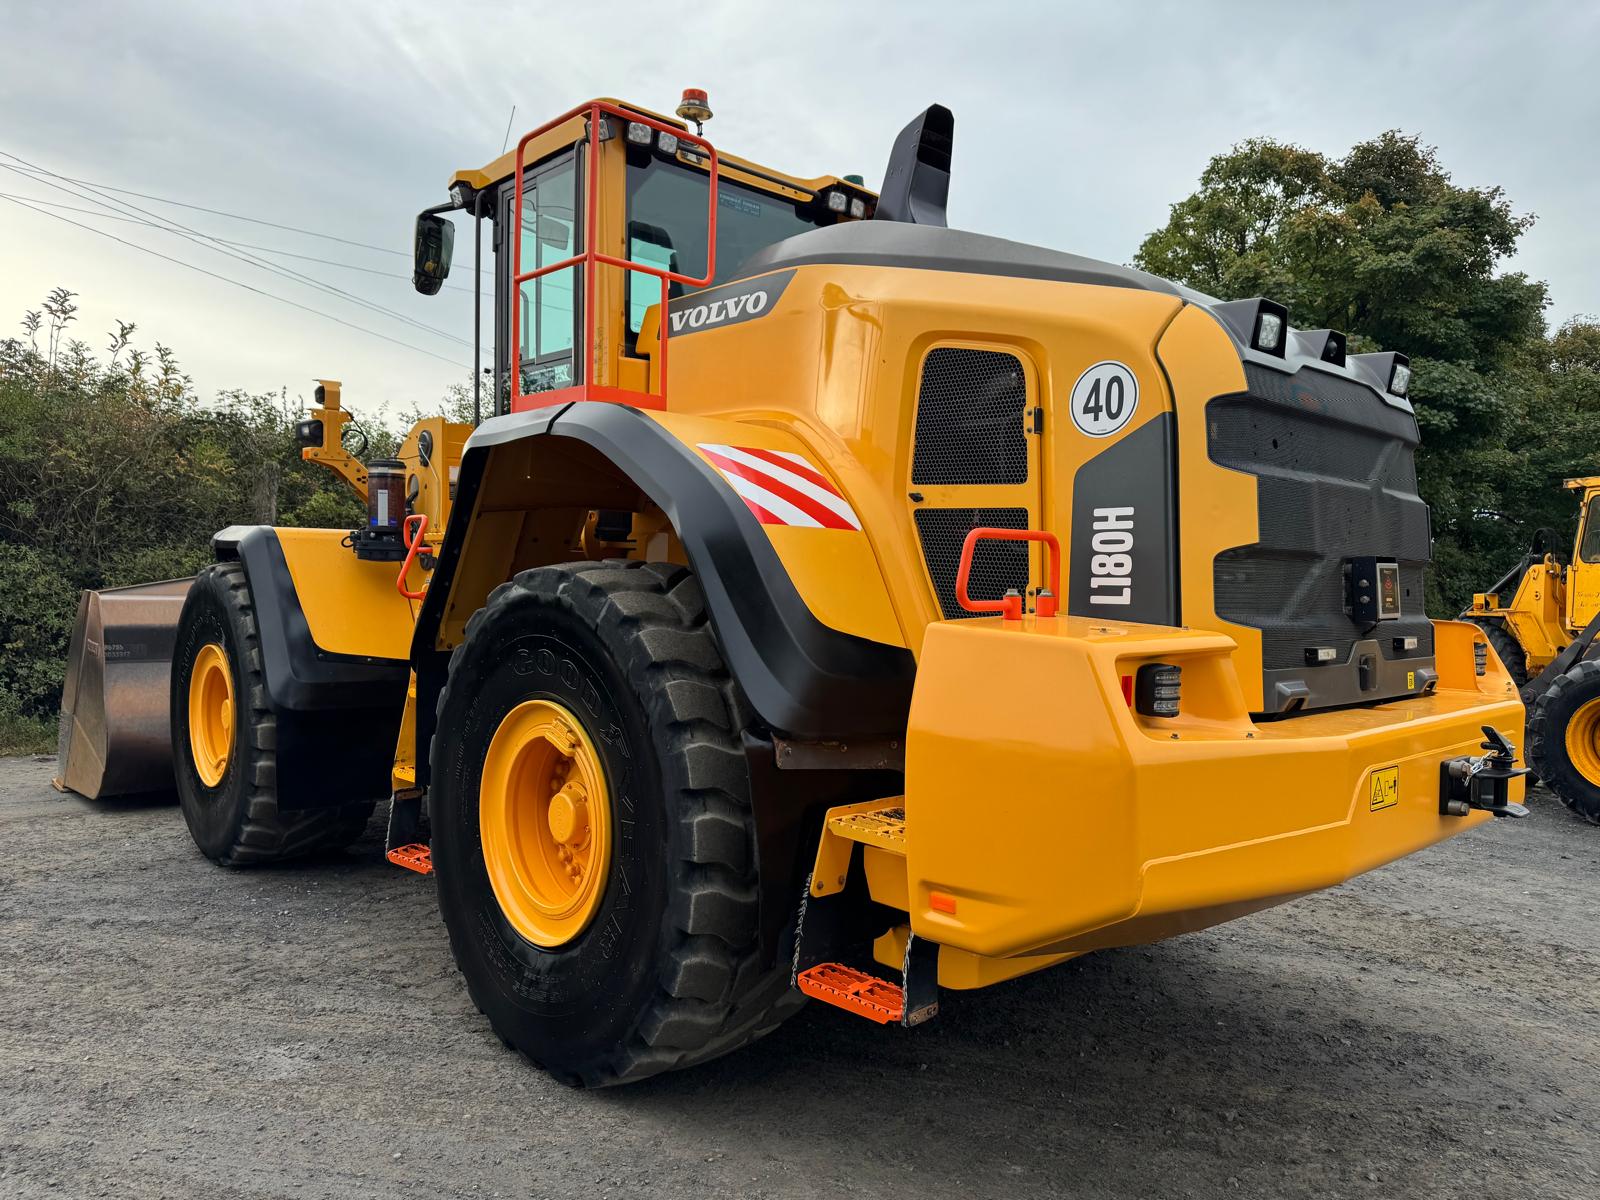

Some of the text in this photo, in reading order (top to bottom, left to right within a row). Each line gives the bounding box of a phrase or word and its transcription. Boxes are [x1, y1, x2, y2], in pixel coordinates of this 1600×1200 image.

[669, 290, 768, 332] VOLVO
[1082, 375, 1125, 422] 40
[1089, 506, 1135, 605] L180H
